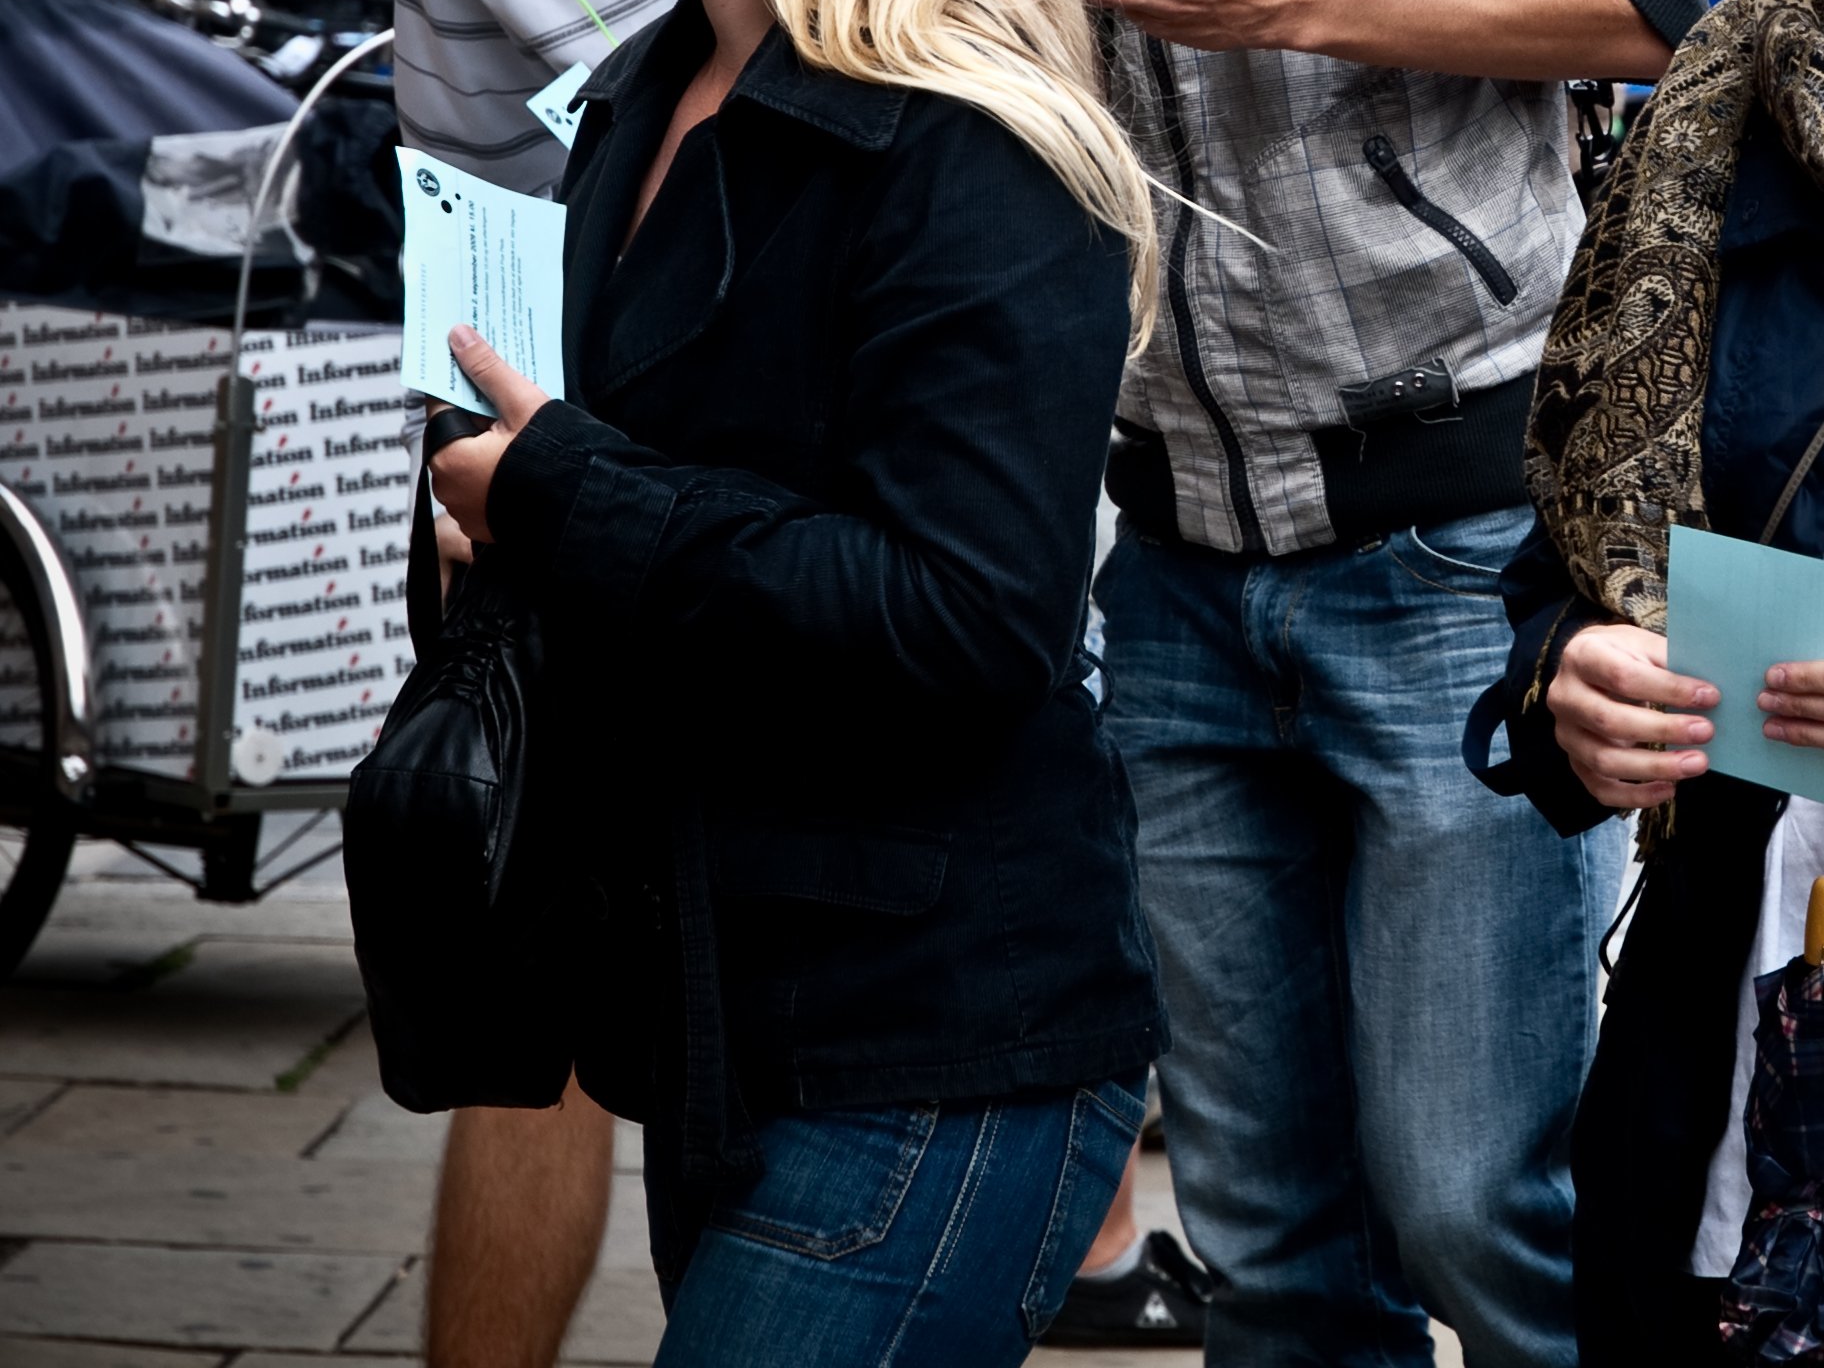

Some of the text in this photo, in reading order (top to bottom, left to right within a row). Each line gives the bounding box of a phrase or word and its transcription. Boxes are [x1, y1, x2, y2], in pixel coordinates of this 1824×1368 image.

[471, 254, 479, 295] september
[31, 346, 128, 382] Information
[297, 357, 400, 386] Informat
[39, 383, 136, 420] Information
[46, 422, 143, 457] Information
[53, 459, 150, 495] Information
[242, 545, 348, 585] ormation
[242, 582, 360, 623] formation
[237, 619, 372, 661] nformation
[241, 654, 384, 701] Information
